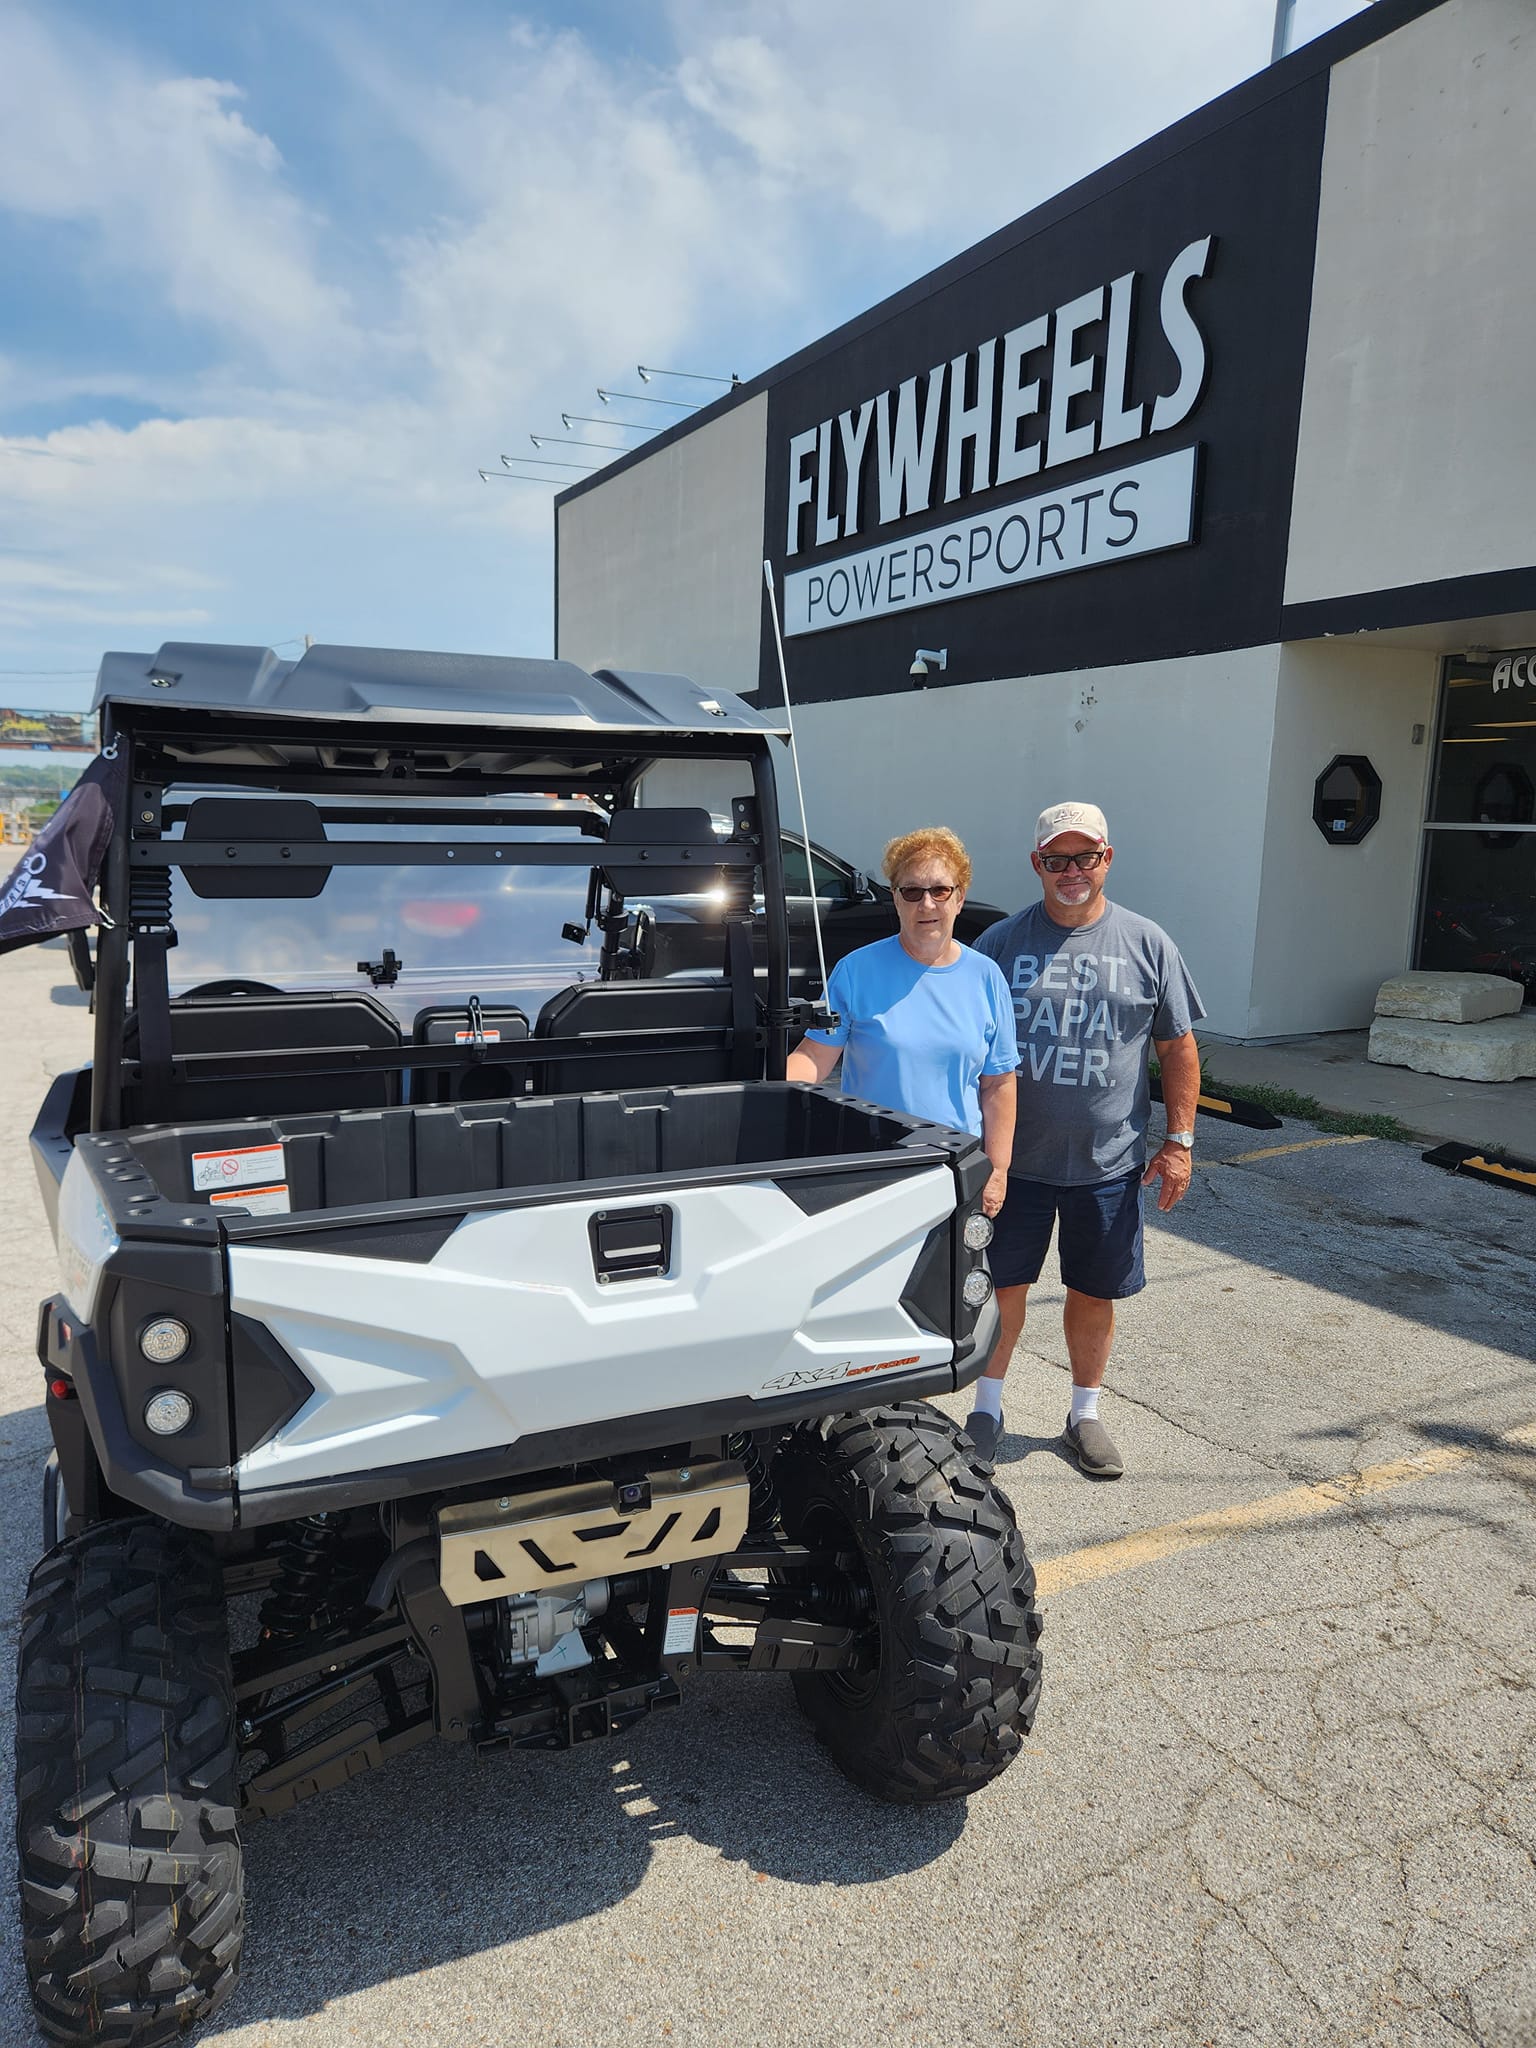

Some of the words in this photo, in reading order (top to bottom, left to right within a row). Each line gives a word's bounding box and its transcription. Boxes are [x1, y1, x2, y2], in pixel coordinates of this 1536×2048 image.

[786, 234, 1215, 557] FLYWHEELS
[807, 480, 1141, 623] POWERSPORTS
[1011, 952, 1131, 995] BEST.
[1015, 1040, 1117, 1087] VER.
